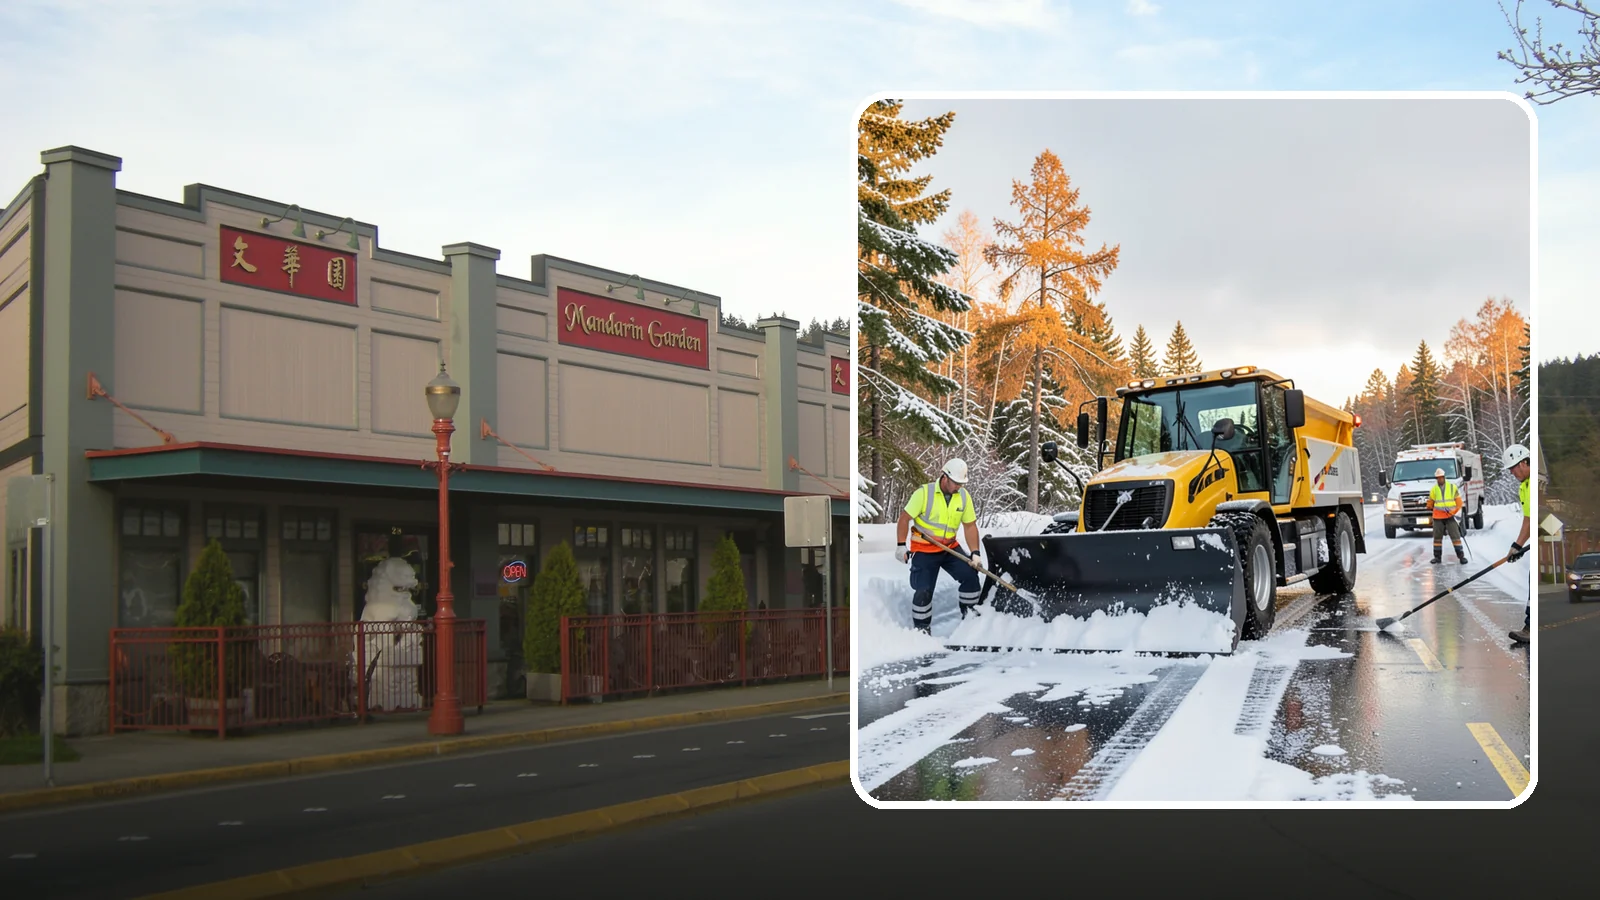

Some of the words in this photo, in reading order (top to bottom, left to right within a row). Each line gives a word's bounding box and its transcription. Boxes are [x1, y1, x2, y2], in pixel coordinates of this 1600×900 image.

[231, 235, 347, 291] 文華園
[564, 302, 645, 341] Mandarin
[647, 320, 702, 352] Garden
[503, 565, 527, 579] OPEN
